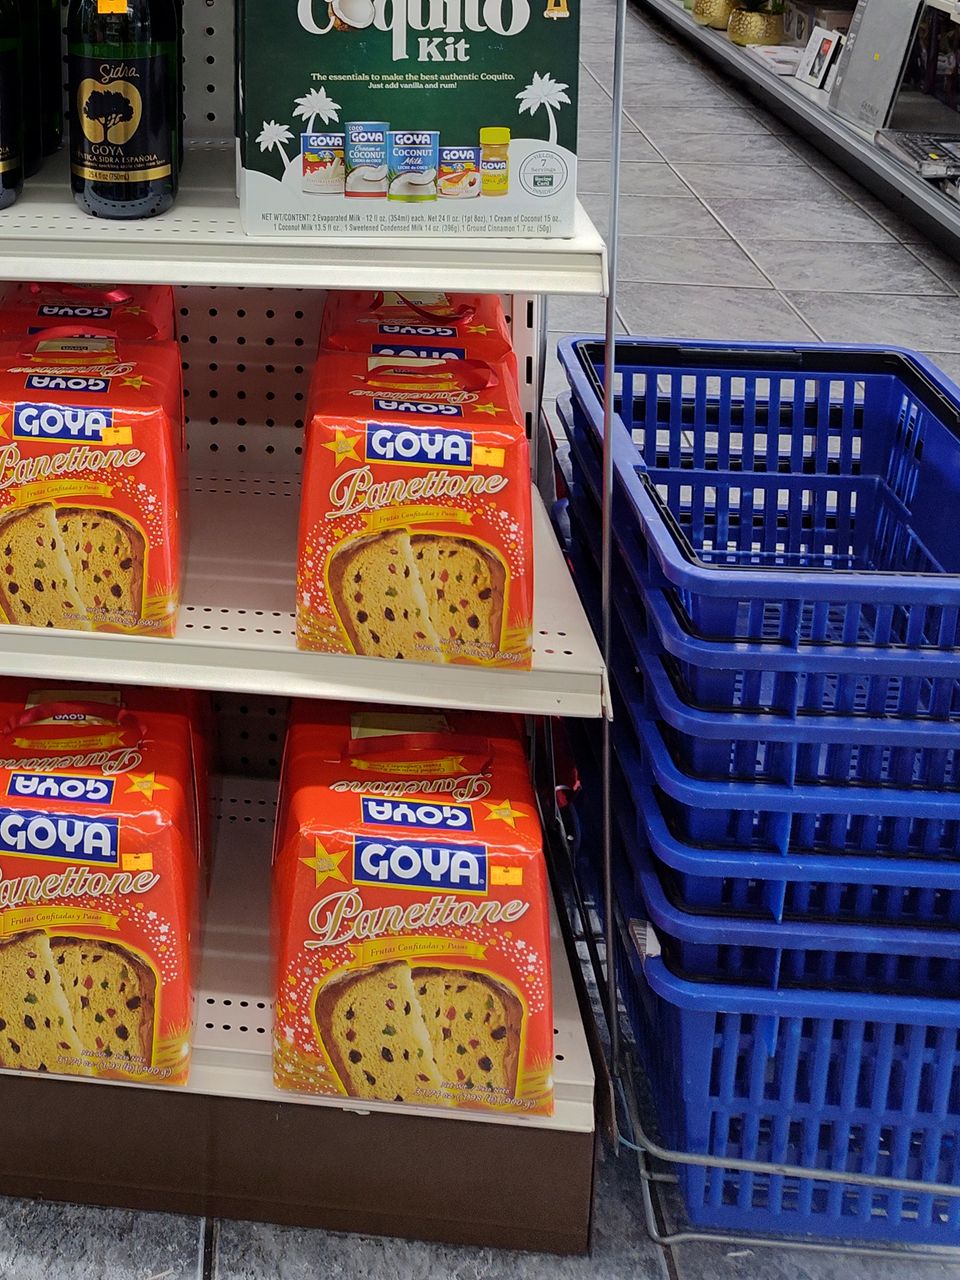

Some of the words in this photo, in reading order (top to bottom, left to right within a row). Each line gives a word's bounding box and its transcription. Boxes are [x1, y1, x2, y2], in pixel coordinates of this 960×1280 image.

[417, 37, 470, 62] Kit
[99, 63, 139, 84] Sidra
[310, 136, 343, 146] GOYA
[351, 133, 383, 142] GOYA
[396, 134, 431, 144] GOYA
[91, 145, 124, 155] GOYA
[349, 150, 385, 159] COCONUT
[393, 148, 433, 157] COCONUT
[443, 150, 475, 160] GOYA
[98, 155, 119, 163] SIDRA
[120, 154, 157, 163] ESPAÑOLA
[404, 157, 423, 165] Milk
[482, 161, 506, 169] GOYA
[262, 213, 273, 221] NET
[317, 214, 347, 223] Evaporated
[348, 214, 361, 222] Milk
[380, 224, 410, 232] Condensed
[31, 376, 106, 390] GOYA
[378, 401, 459, 415] GOYA
[18, 408, 105, 436] GOYA
[370, 429, 471, 462] GOYA
[325, 464, 510, 520] Panettone
[14, 777, 107, 800] GOYA
[365, 801, 467, 826] GOYA
[0, 817, 115, 856] GOYA
[360, 844, 483, 885] GOYA
[11, 914, 35, 926] Frutas
[304, 887, 531, 950] Panettone
[370, 944, 395, 957] Frutas
